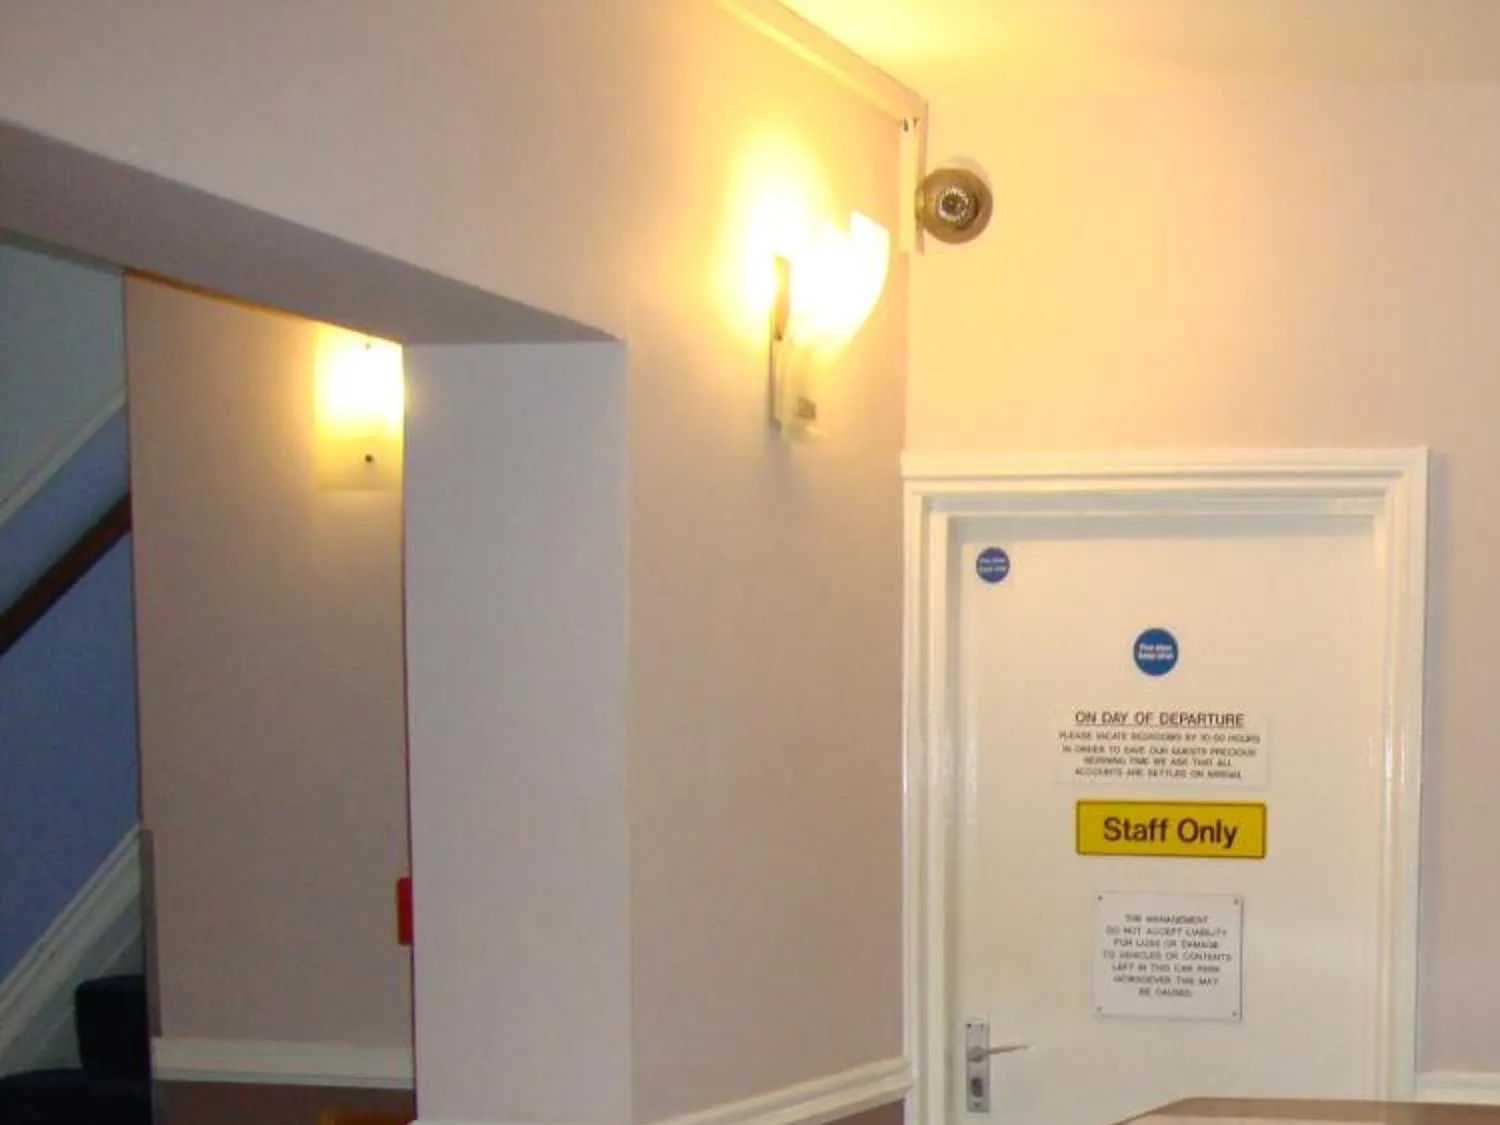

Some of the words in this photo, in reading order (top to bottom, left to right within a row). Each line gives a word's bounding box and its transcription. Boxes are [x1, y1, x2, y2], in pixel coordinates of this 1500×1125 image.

[1075, 711, 1097, 724] ON
[1101, 711, 1128, 725] DAY
[1133, 711, 1153, 726] OF
[1159, 712, 1245, 727] DEPARTURE
[1058, 731, 1092, 741] PLEASE
[1108, 745, 1120, 755] TO
[1170, 757, 1188, 767] ASK
[1193, 757, 1213, 767] THAT
[1217, 758, 1232, 767] ALL
[1103, 816, 1169, 843] Staff
[1177, 817, 1238, 850] Only
[1146, 915, 1209, 925] MANAGEMENT
[1146, 927, 1182, 937] ACCEPT
[1183, 951, 1232, 962] CONTENTS
